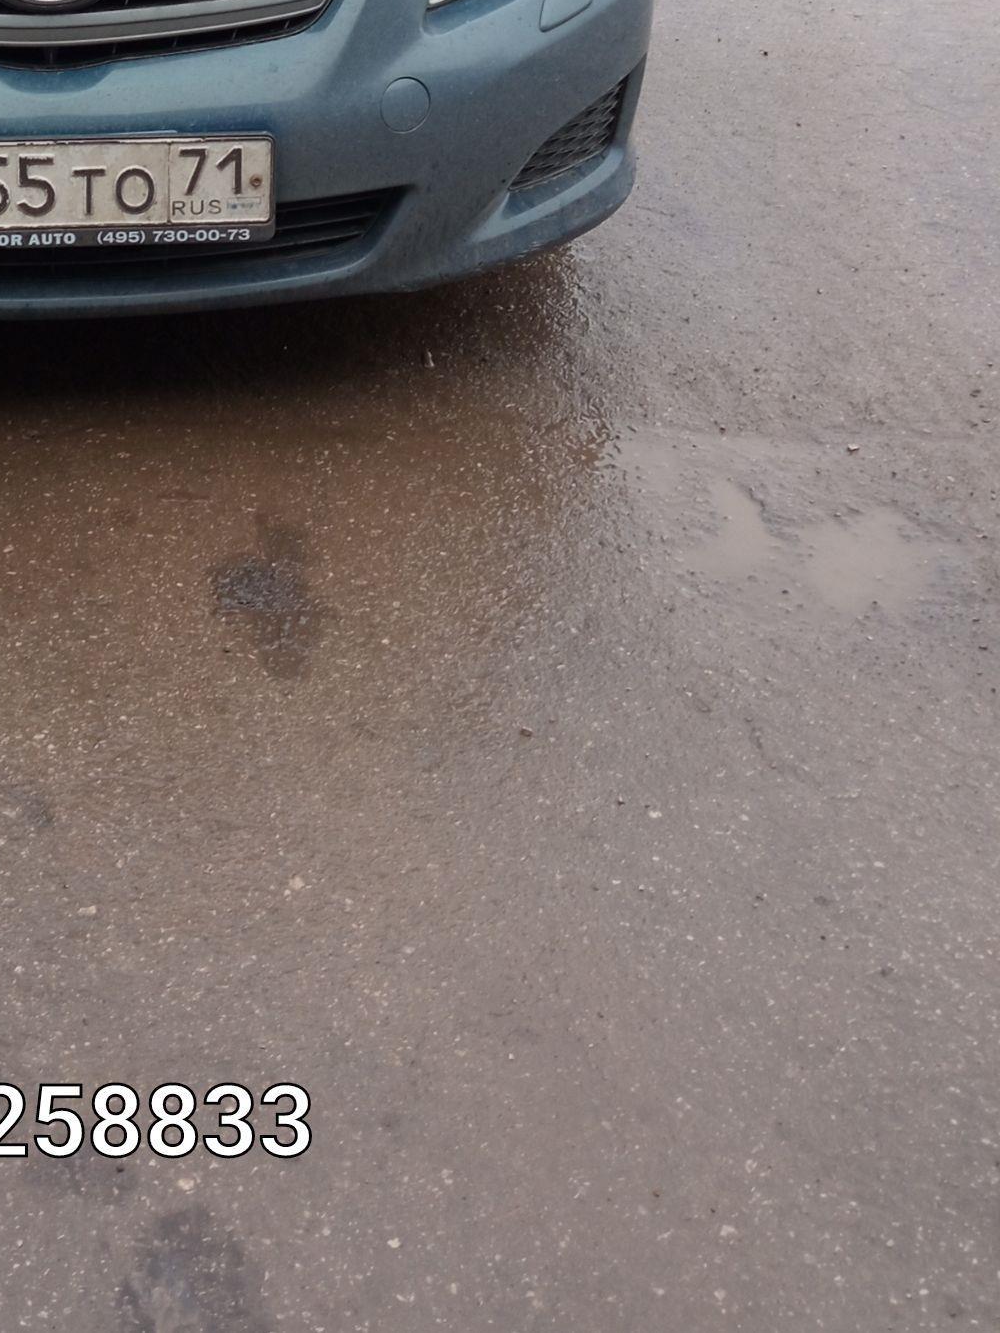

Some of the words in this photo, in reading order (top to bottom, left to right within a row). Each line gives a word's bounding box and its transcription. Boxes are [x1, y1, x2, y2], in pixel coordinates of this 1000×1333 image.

[178, 147, 242, 196] 71
[172, 199, 222, 216] RUS
[28, 232, 76, 245] AUTO
[96, 231, 146, 244] (495)
[152, 228, 251, 243] 730-00-73
